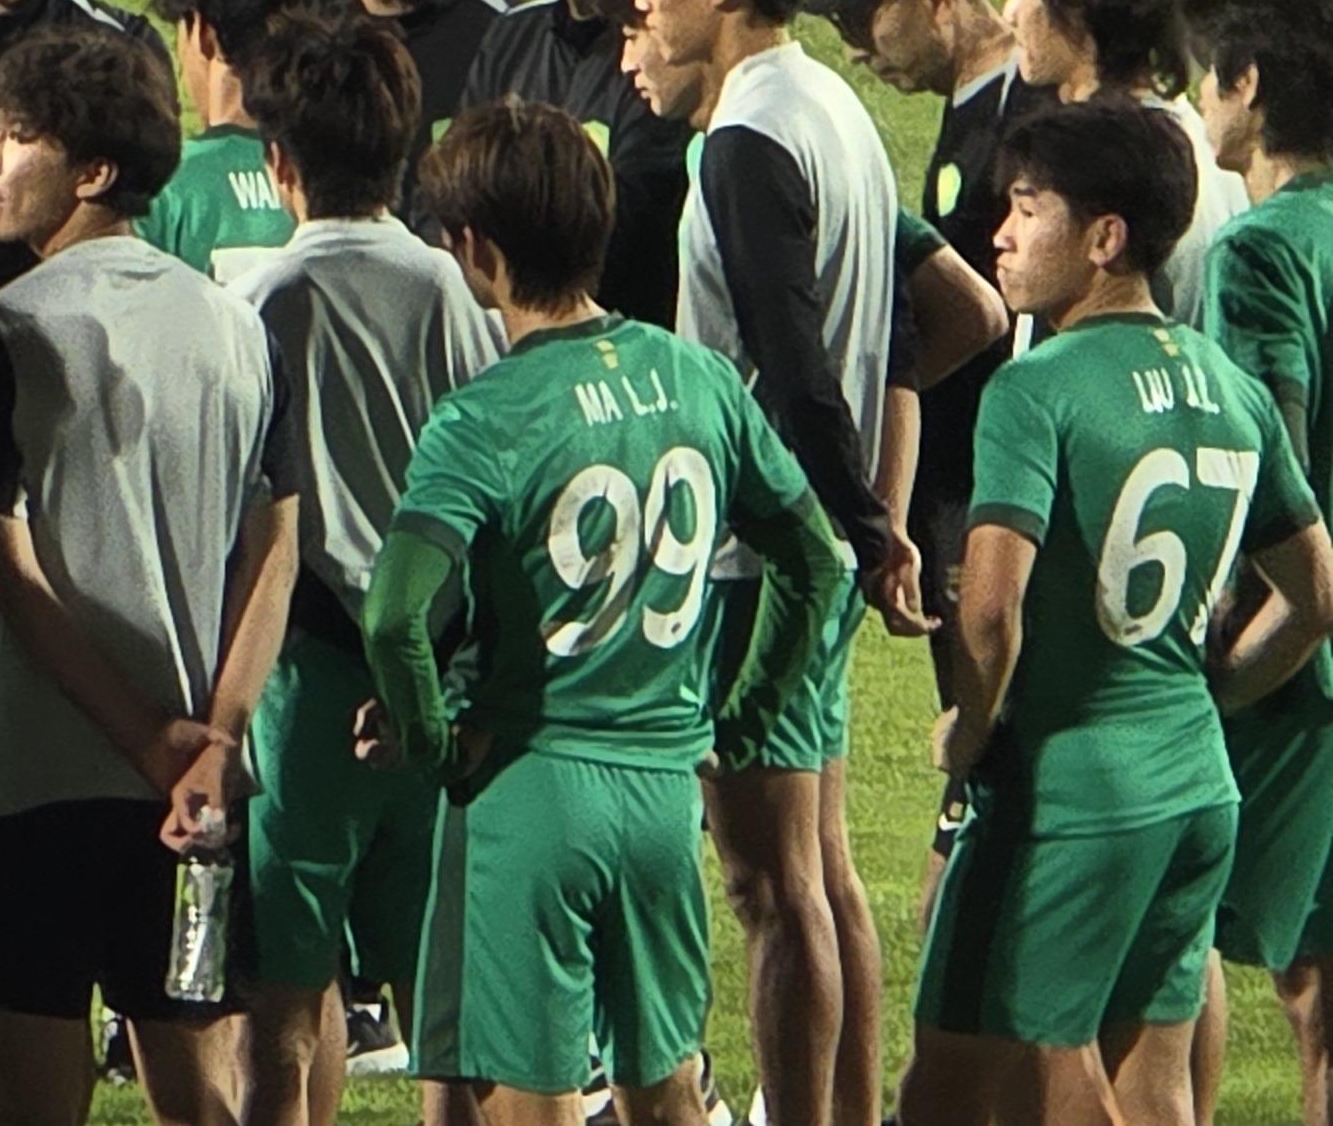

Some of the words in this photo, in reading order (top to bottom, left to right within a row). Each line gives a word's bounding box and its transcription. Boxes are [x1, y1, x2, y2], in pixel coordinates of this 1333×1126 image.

[575, 380, 623, 427] MA
[540, 447, 717, 657] 99
[1096, 447, 1260, 646] 67
